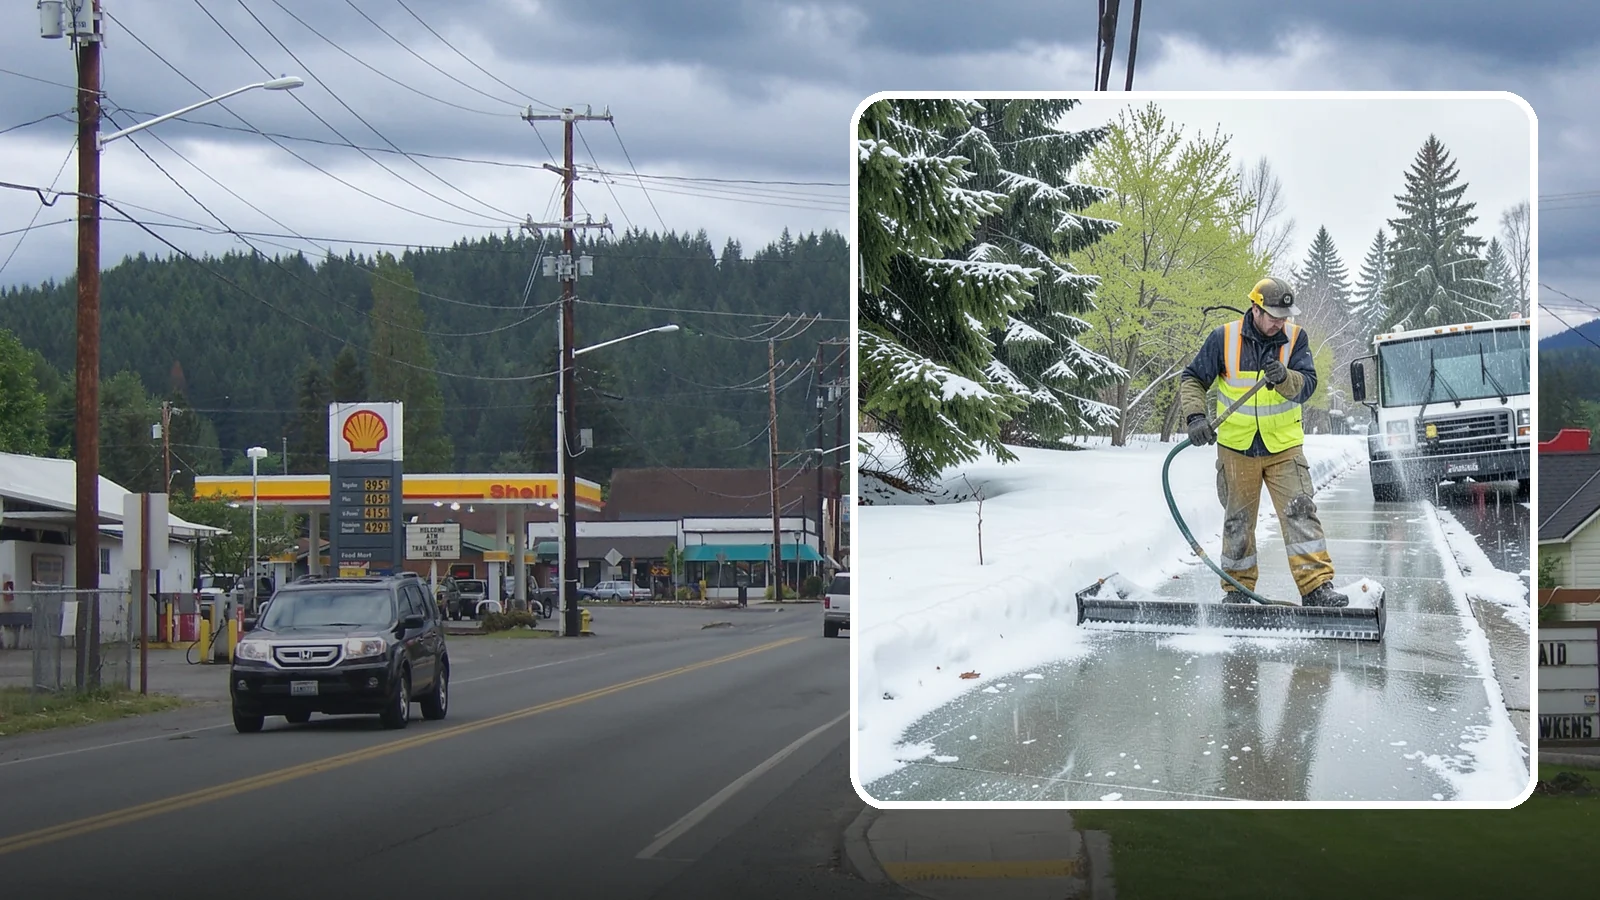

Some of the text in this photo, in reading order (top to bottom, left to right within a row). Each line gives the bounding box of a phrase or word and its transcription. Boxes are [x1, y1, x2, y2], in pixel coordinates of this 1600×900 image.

[366, 480, 384, 490] 395
[490, 484, 547, 499] Shell
[366, 494, 384, 504] 405
[366, 508, 384, 518] 415
[366, 522, 384, 532] 429
